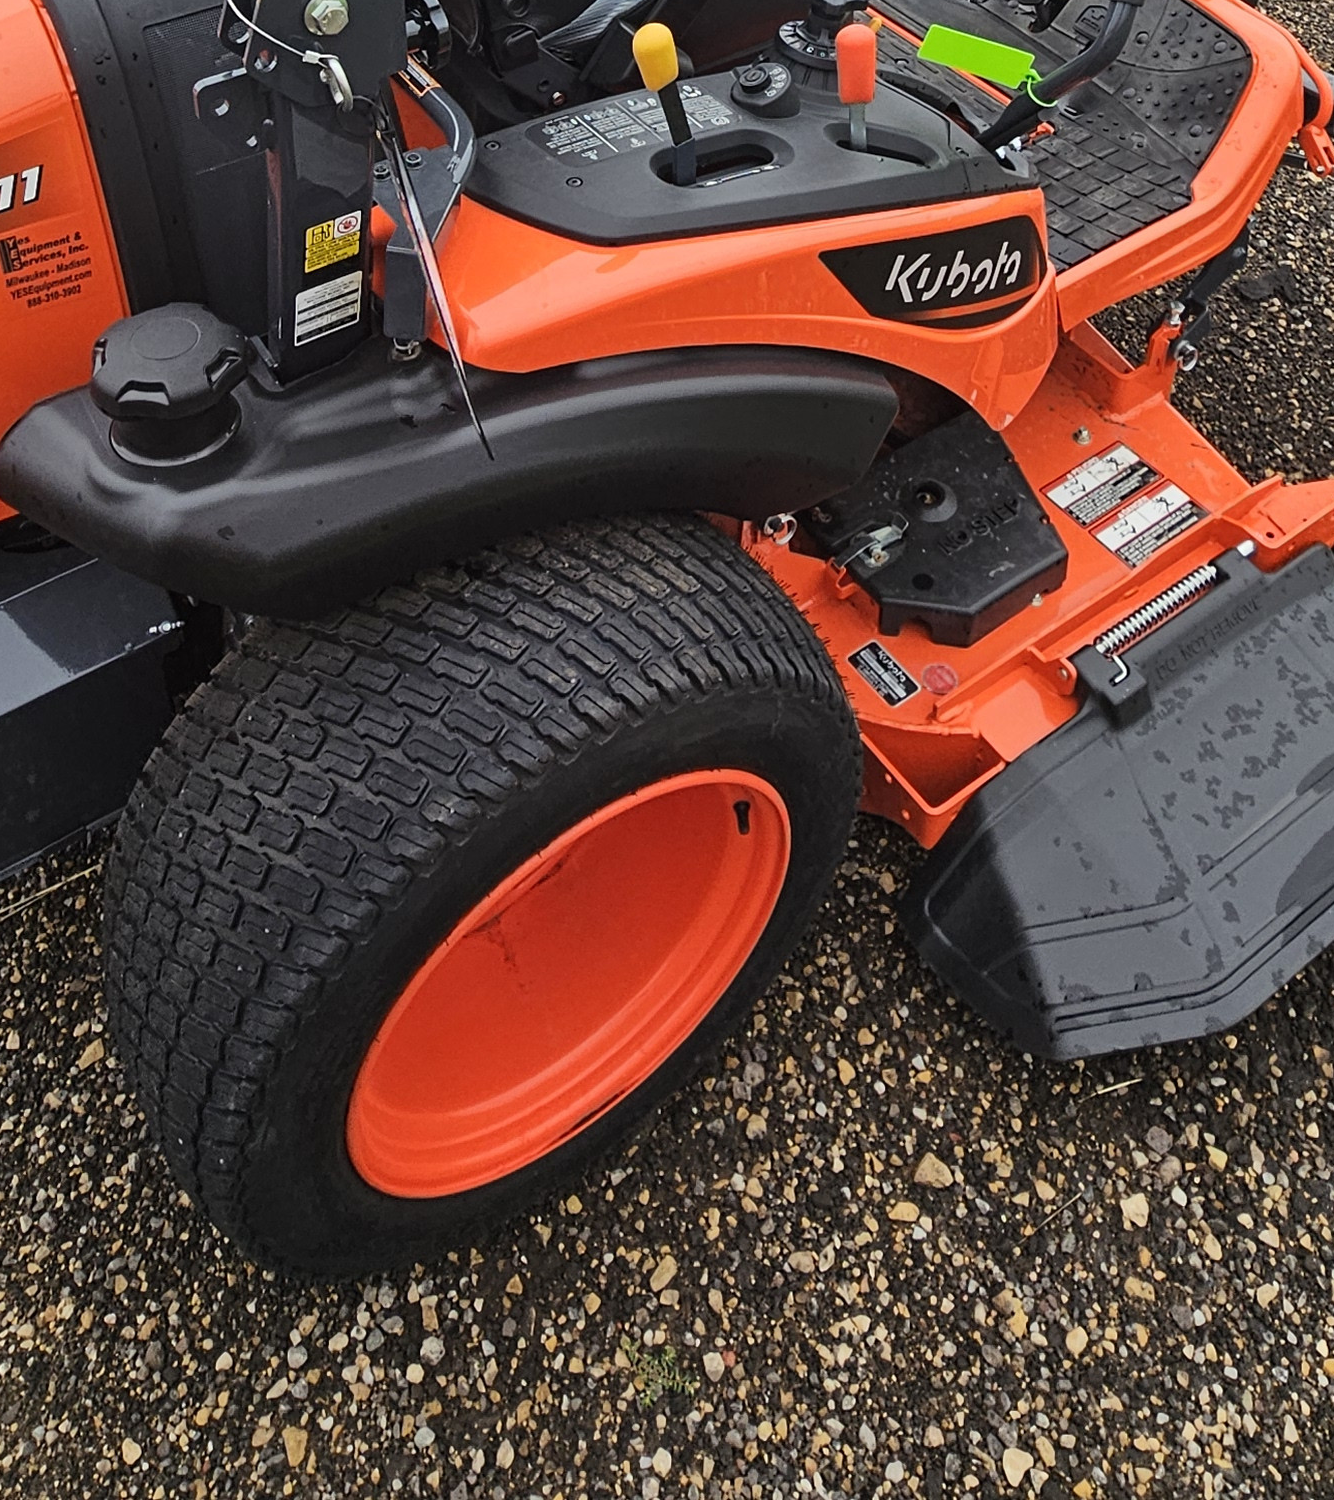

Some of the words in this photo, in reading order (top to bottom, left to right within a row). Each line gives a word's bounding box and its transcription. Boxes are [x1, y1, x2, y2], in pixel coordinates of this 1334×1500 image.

[6, 236, 31, 250] Yes
[10, 234, 71, 259] Equipment
[73, 231, 82, 241] &
[12, 250, 66, 270] Services,
[68, 243, 89, 255] Inc.
[5, 269, 50, 288] Milwaukee
[56, 256, 92, 274] Madison
[10, 270, 92, 301] YESEquipment.com
[884, 241, 1022, 304] Kubota
[26, 284, 82, 309] 888-310-3902
[877, 650, 907, 683] Kubota
